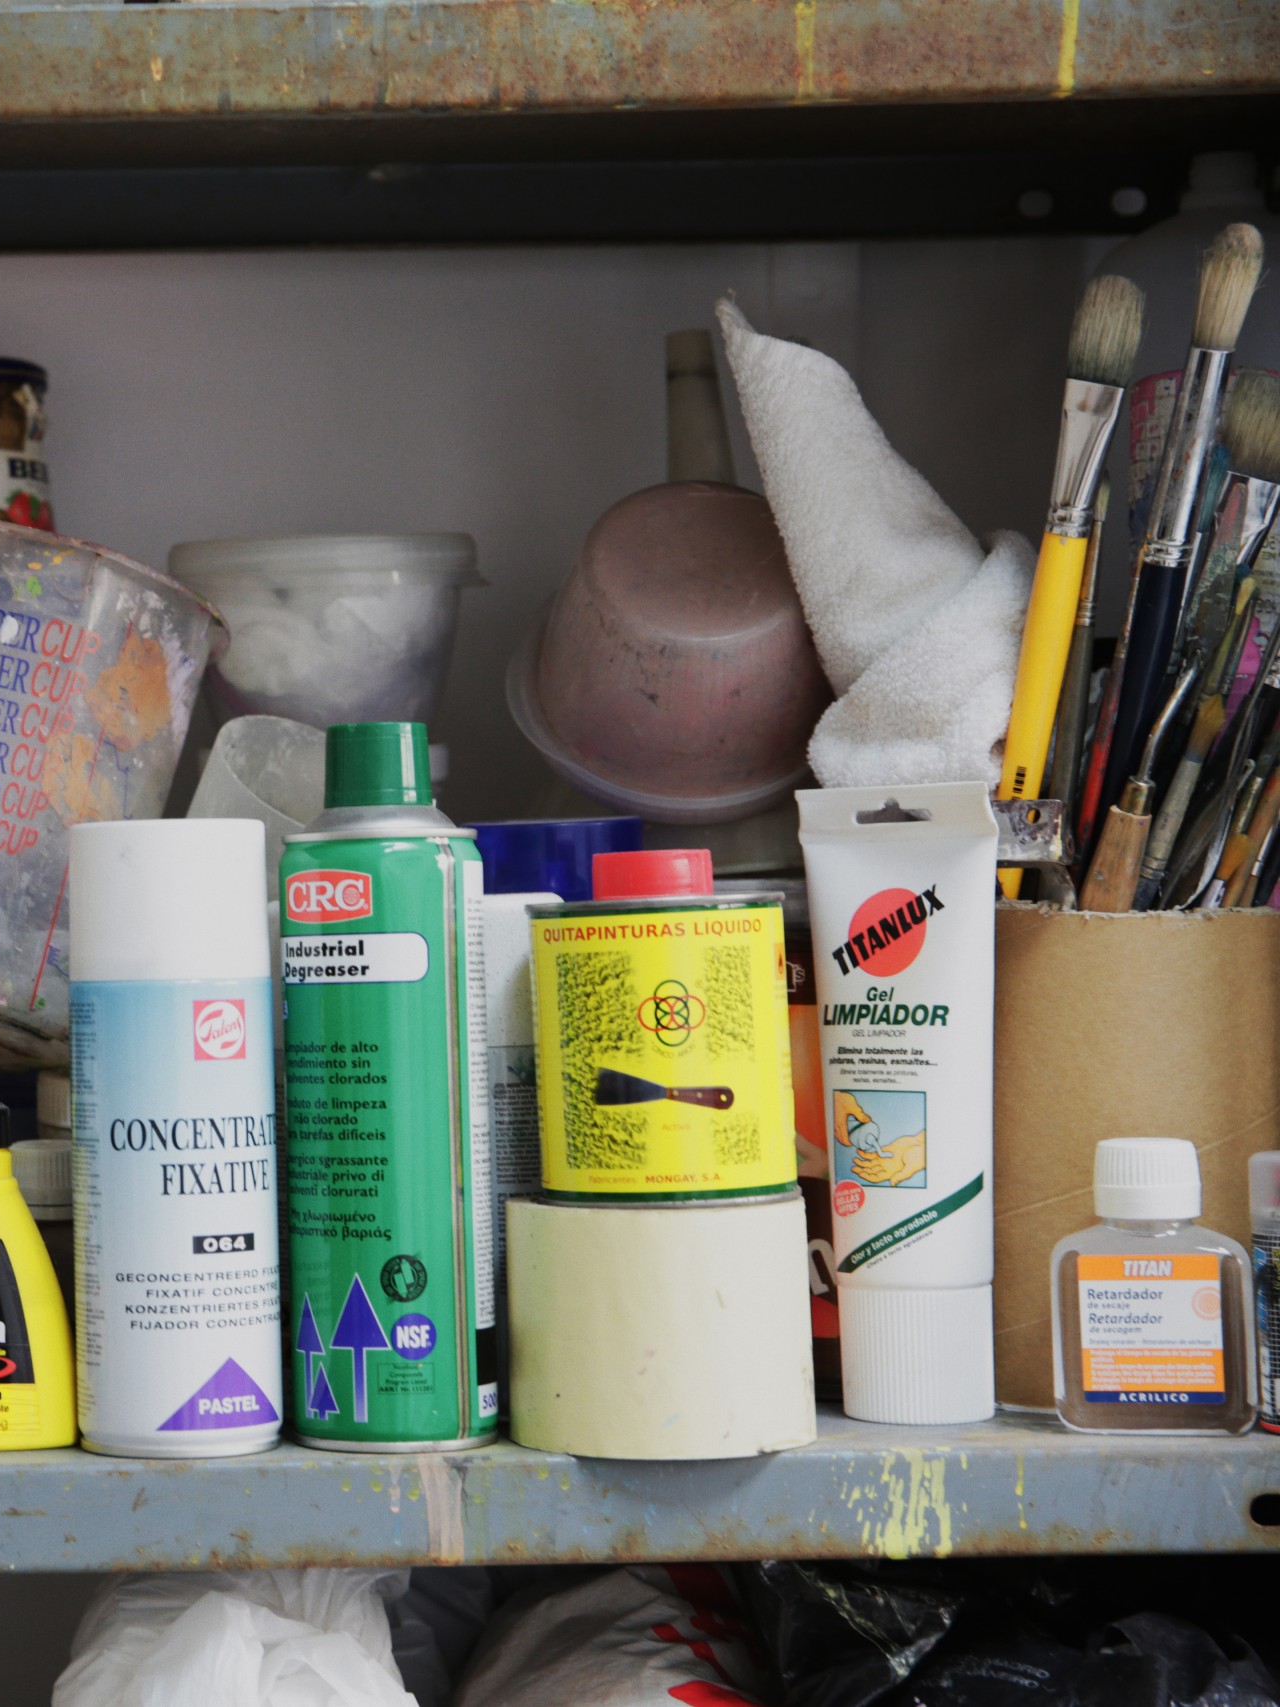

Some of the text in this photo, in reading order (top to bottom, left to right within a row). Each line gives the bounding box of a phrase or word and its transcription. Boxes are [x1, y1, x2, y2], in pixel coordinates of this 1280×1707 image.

[289, 879, 365, 913] CRC
[543, 923, 685, 944] QUITAPINTURAS
[831, 883, 945, 977] TITANLUX
[285, 940, 364, 958] Industrial
[285, 962, 369, 982] Degreaser
[866, 986, 895, 1002] Gel
[823, 1004, 950, 1026] LIMPIADOR
[330, 1041, 378, 1053] de alto
[351, 1057, 371, 1069] sin
[329, 1072, 388, 1085] clorados
[314, 1096, 387, 1112] de limpeza
[312, 1113, 359, 1126] clorado
[319, 1156, 389, 1169] sgrassante
[160, 1159, 269, 1196] FIXATIVE
[332, 1169, 385, 1185] privo di
[645, 1174, 698, 1185] MONGAY,
[321, 1184, 379, 1198] clorurati
[872, 1234, 894, 1251] tacto
[893, 1209, 938, 1238] agradable
[203, 1236, 246, 1253] 064
[116, 1268, 259, 1283] GECONCENTREERD
[1122, 1259, 1173, 1277] TITAN
[146, 1288, 206, 1299] FIXATIF
[1087, 1288, 1163, 1300] Retardador
[125, 1301, 259, 1314] KONZENTRIERTES
[1087, 1301, 1131, 1311] de secaje
[130, 1319, 200, 1331] FIJADOR
[1088, 1312, 1163, 1325] Retardador
[395, 1325, 431, 1349] NSF
[1089, 1326, 1100, 1334] de
[198, 1395, 260, 1415] PASTEL
[1118, 1393, 1189, 1403] ACRILICO
